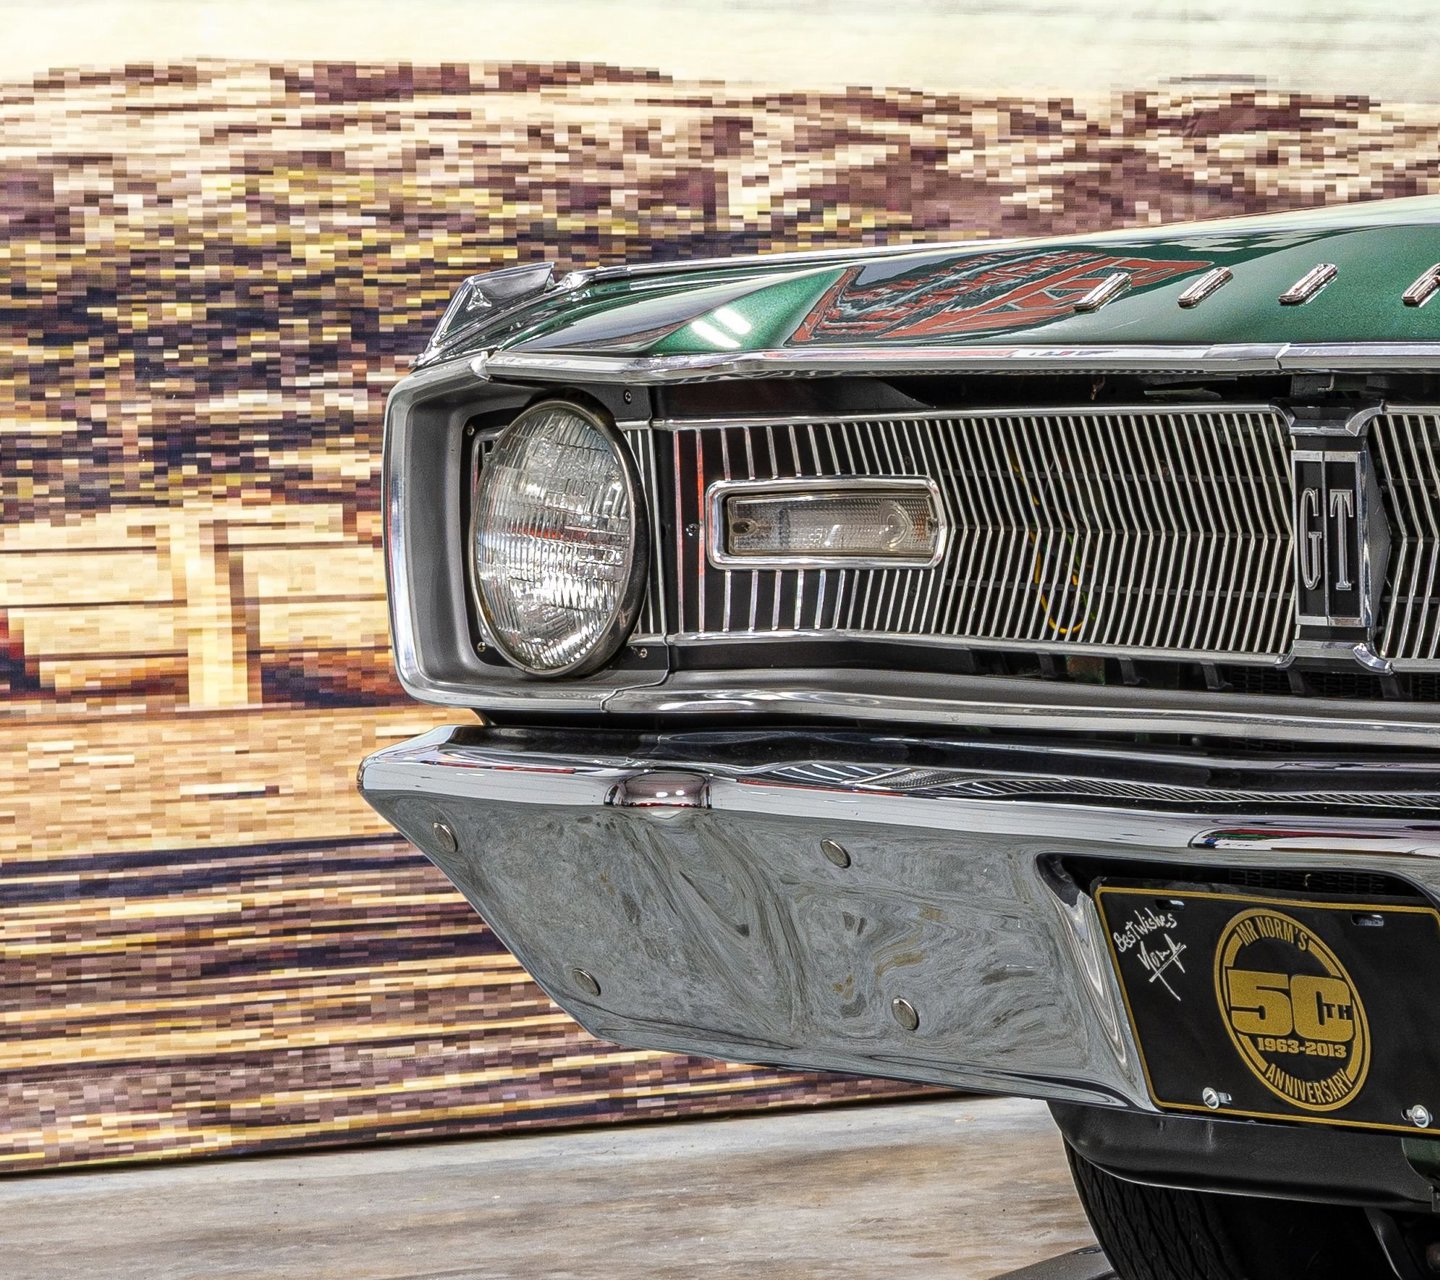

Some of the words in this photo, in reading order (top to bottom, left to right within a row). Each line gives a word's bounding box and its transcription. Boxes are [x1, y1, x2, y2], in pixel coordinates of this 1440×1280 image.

[1299, 487, 1354, 591] GT
[1235, 918, 1259, 947] MR
[1255, 916, 1310, 952] NORM'S
[1257, 1036, 1347, 1059] 1963-2013
[1265, 1062, 1354, 1104] ANNIVERSARY
